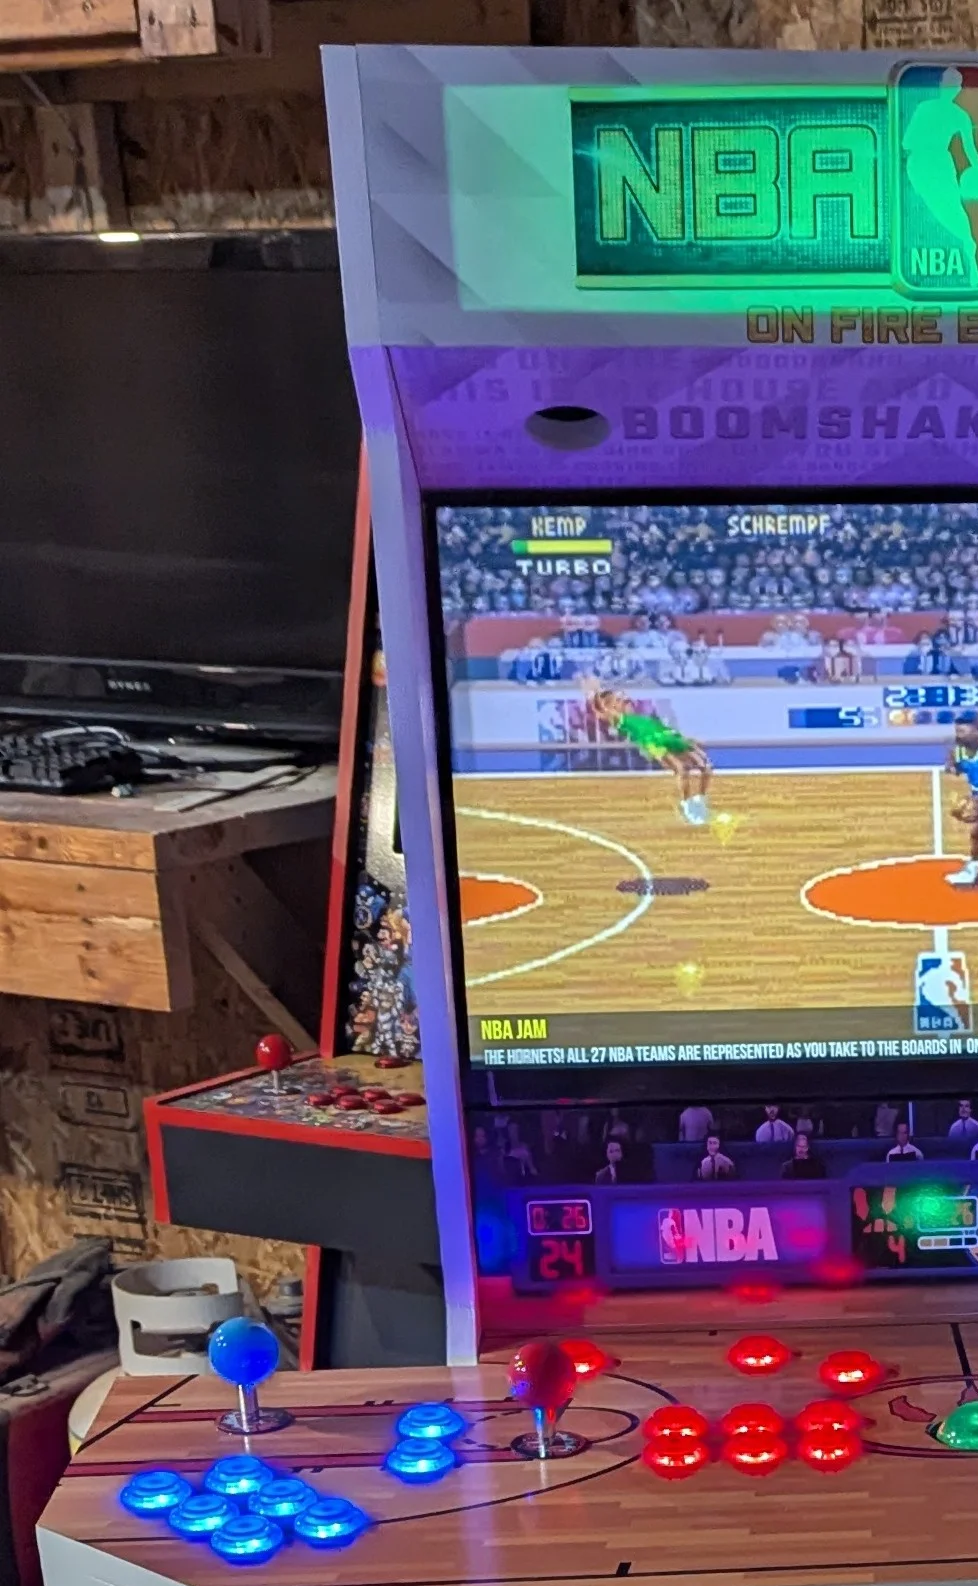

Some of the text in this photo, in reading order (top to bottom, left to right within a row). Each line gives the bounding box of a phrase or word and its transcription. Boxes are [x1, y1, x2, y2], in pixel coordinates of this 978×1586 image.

[594, 125, 881, 246] NBA
[910, 246, 965, 277] NBA
[747, 306, 815, 344] ON
[830, 306, 943, 344] FIRE
[687, 378, 838, 401] HOUSE
[531, 516, 588, 537] KEMP
[727, 513, 831, 536] SCHREMPF
[515, 559, 612, 576] TURBO
[480, 1018, 548, 1040] NBA JAM
[507, 1047, 565, 1065] HORNETS!
[567, 1047, 589, 1063] ALL
[591, 1046, 606, 1063] 27
[609, 1046, 634, 1062] NBA
[636, 1045, 675, 1062] TEAMS
[678, 1045, 702, 1060] ARE
[703, 1042, 783, 1061] REPRESENTED
[786, 1042, 802, 1058] AS
[803, 1041, 827, 1058] YOU
[828, 1041, 859, 1057] TAKE
[860, 1041, 876, 1056] TO
[877, 1040, 900, 1056] THE
[902, 1039, 948, 1055] BOARDS
[950, 1039, 962, 1054] IN
[682, 1206, 779, 1263] NBA
[539, 1239, 583, 1278] 24
